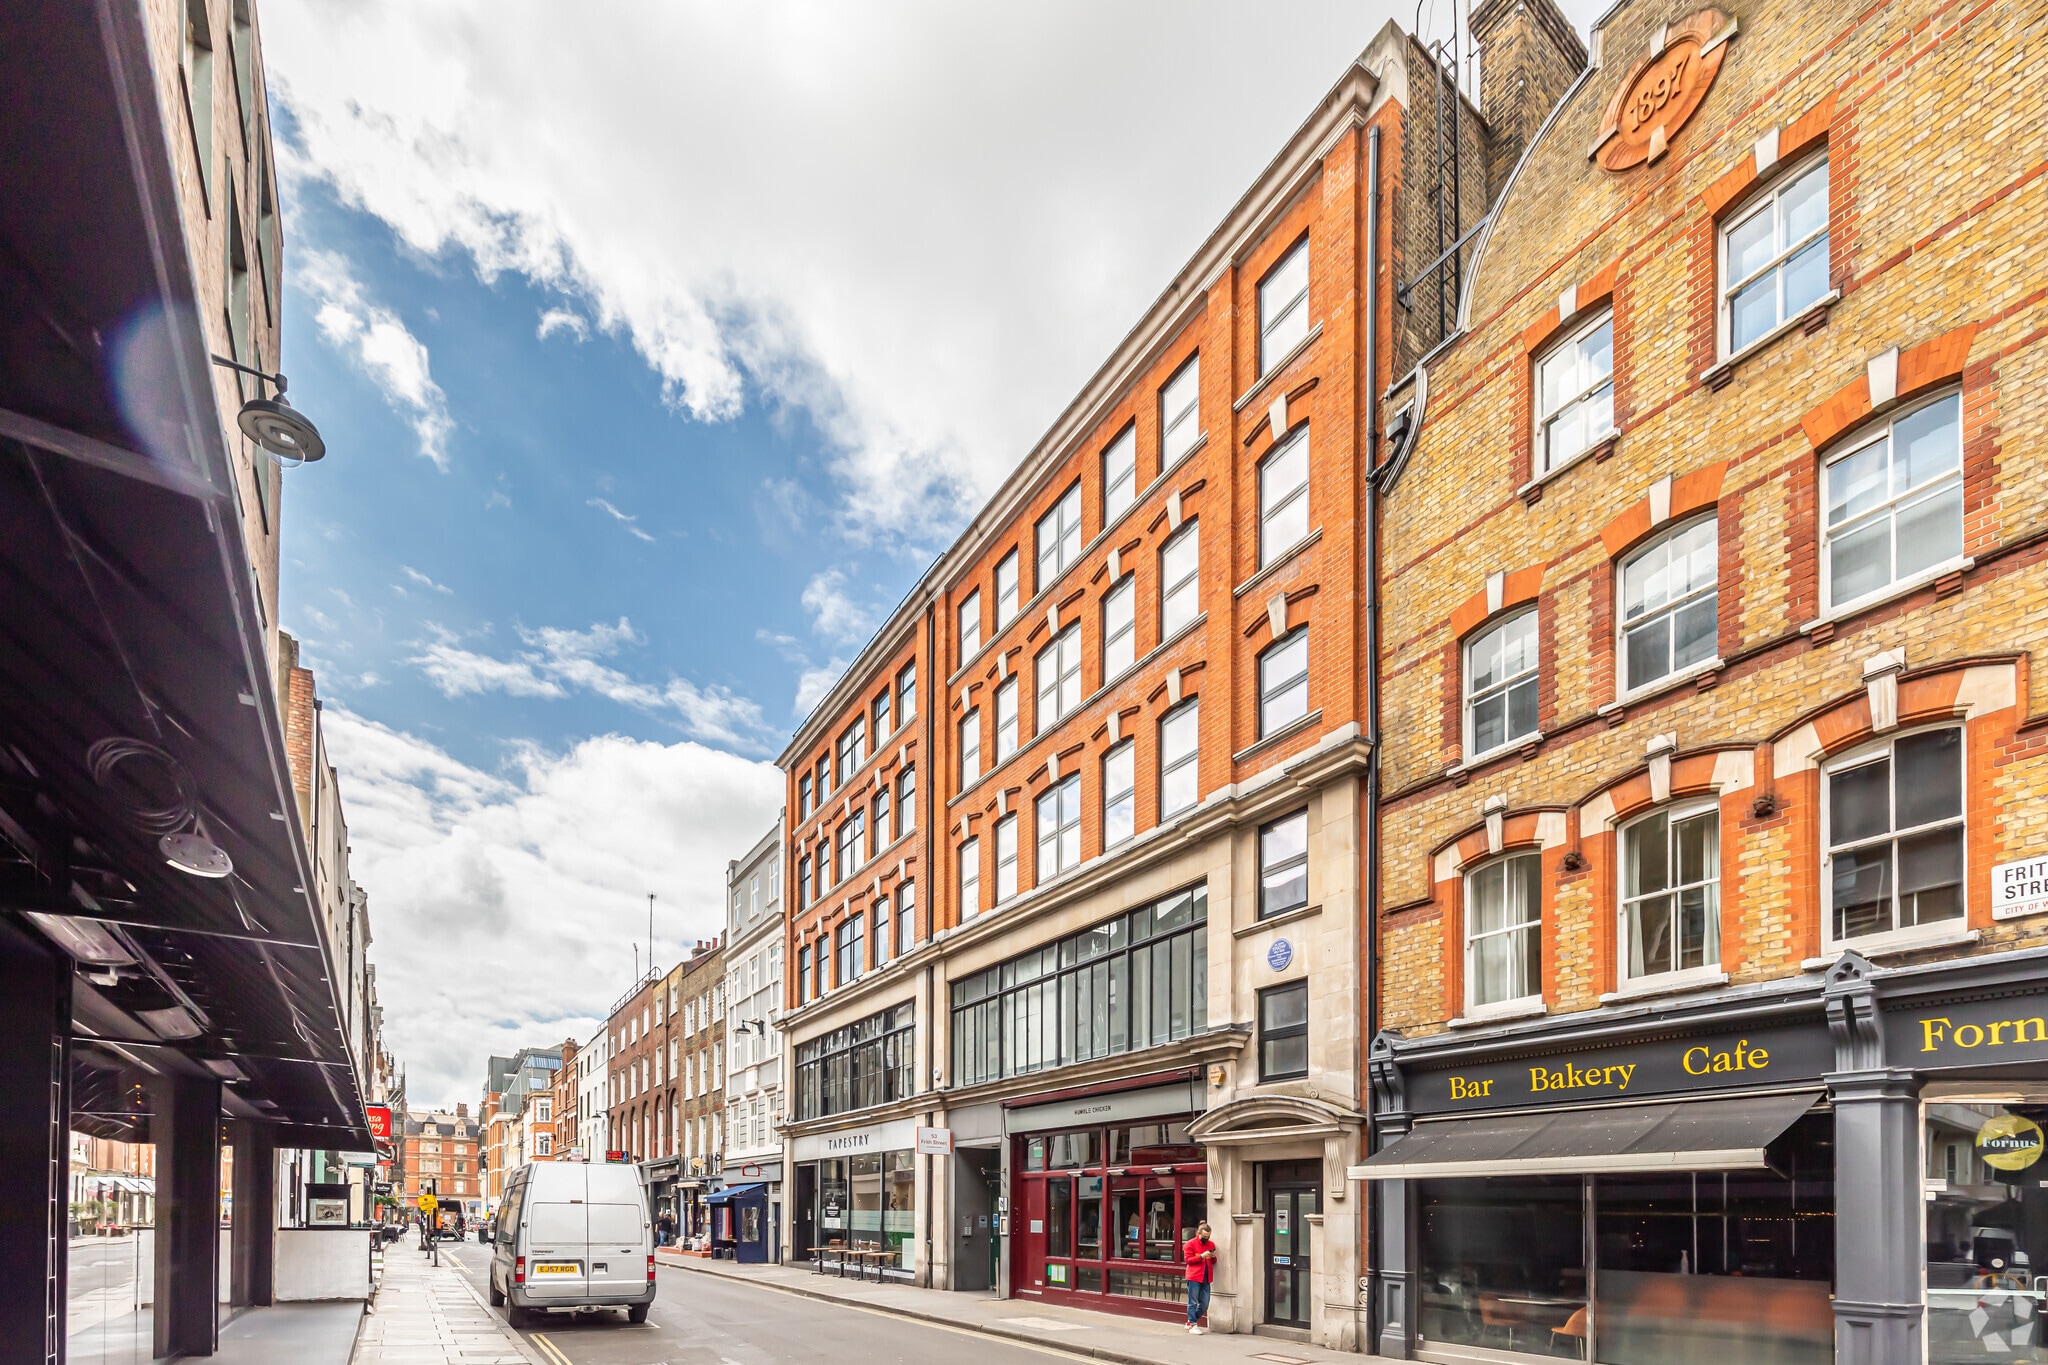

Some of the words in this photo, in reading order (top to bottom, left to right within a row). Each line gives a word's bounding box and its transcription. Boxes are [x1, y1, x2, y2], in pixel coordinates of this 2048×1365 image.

[1630, 54, 1691, 133] 1897
[2005, 862, 2047, 883] FRIT
[2005, 905, 2025, 915] CITY
[2028, 902, 2040, 911] OF
[1918, 1016, 2048, 1052] Forn
[1448, 1076, 1494, 1100] Bar
[1529, 1062, 1637, 1090] Bakery
[1682, 1039, 1770, 1076] Cafe
[1092, 1105, 1112, 1113] CHICKEN
[828, 1134, 869, 1150] TAPESTRY
[1981, 1136, 2039, 1148] Fornus
[540, 1265, 559, 1273] EJ57
[560, 1265, 575, 1273] RGO
